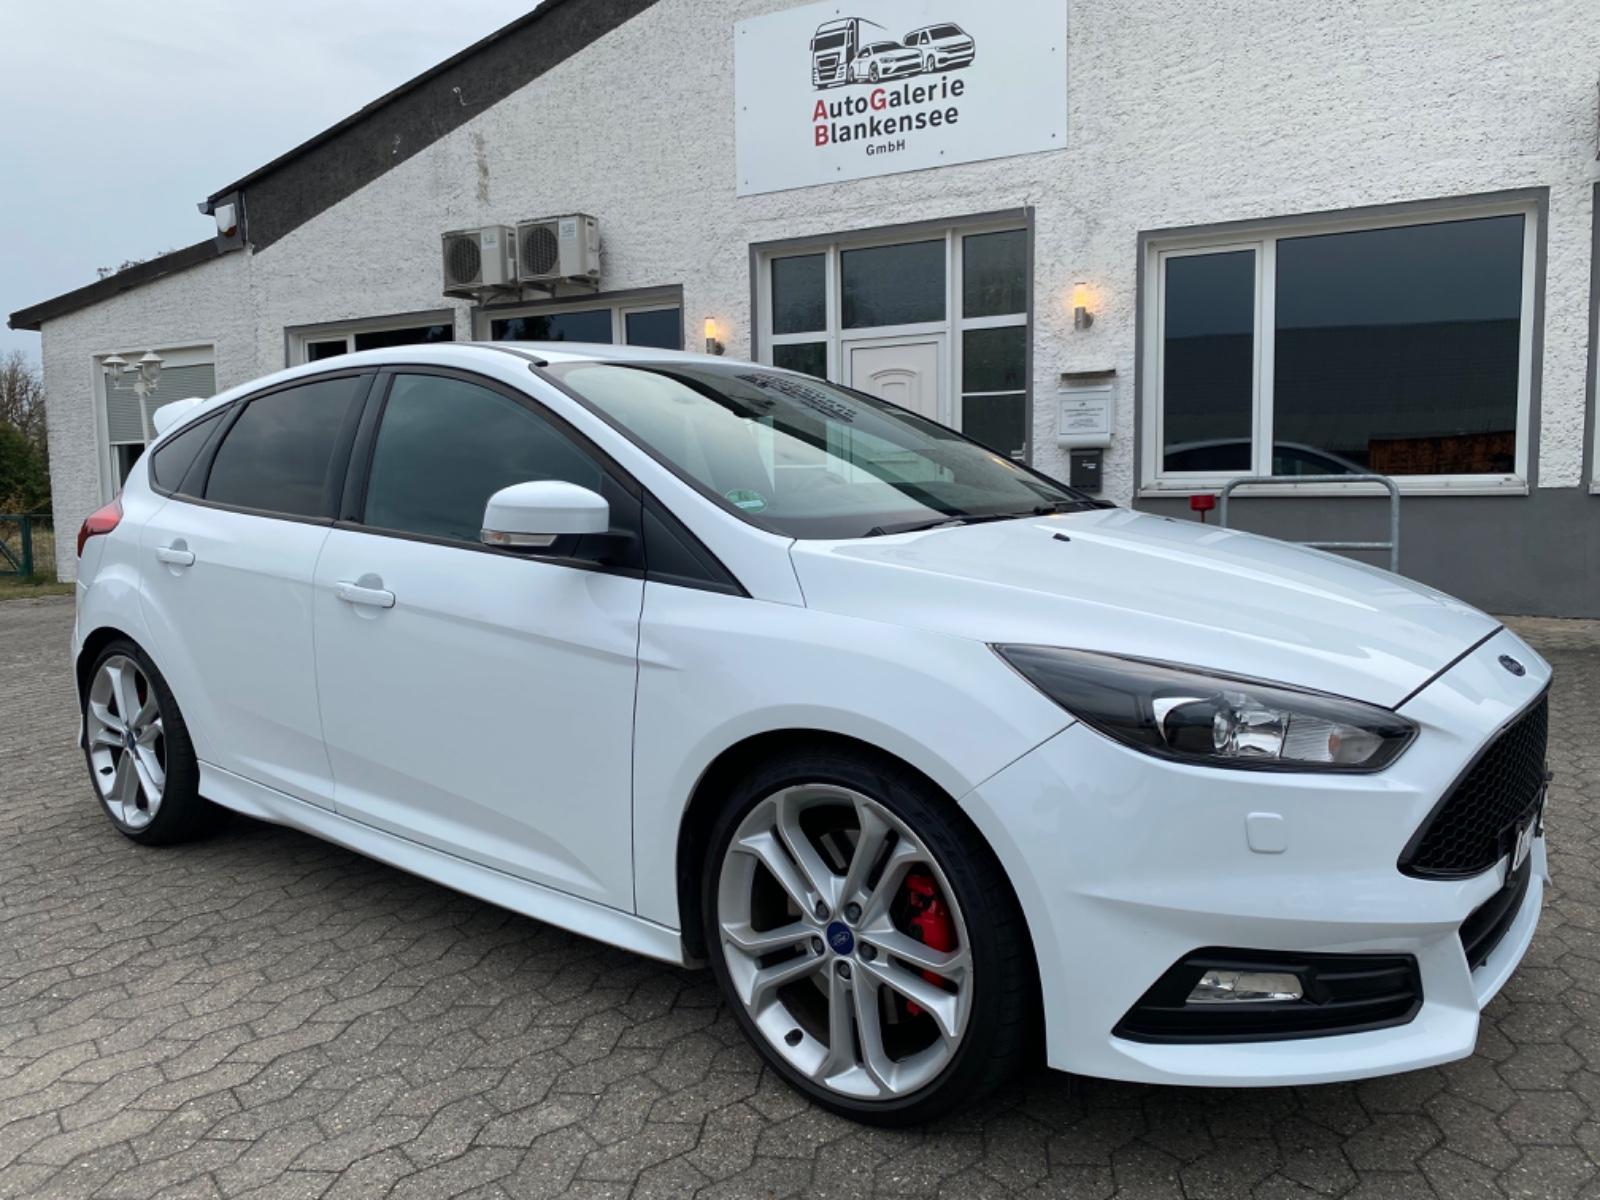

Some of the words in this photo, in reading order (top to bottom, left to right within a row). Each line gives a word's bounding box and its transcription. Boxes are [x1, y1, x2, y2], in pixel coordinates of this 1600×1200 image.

[812, 75, 965, 122] AutoGalerie
[815, 106, 959, 147] Blankensee
[866, 139, 906, 156] GmbH
